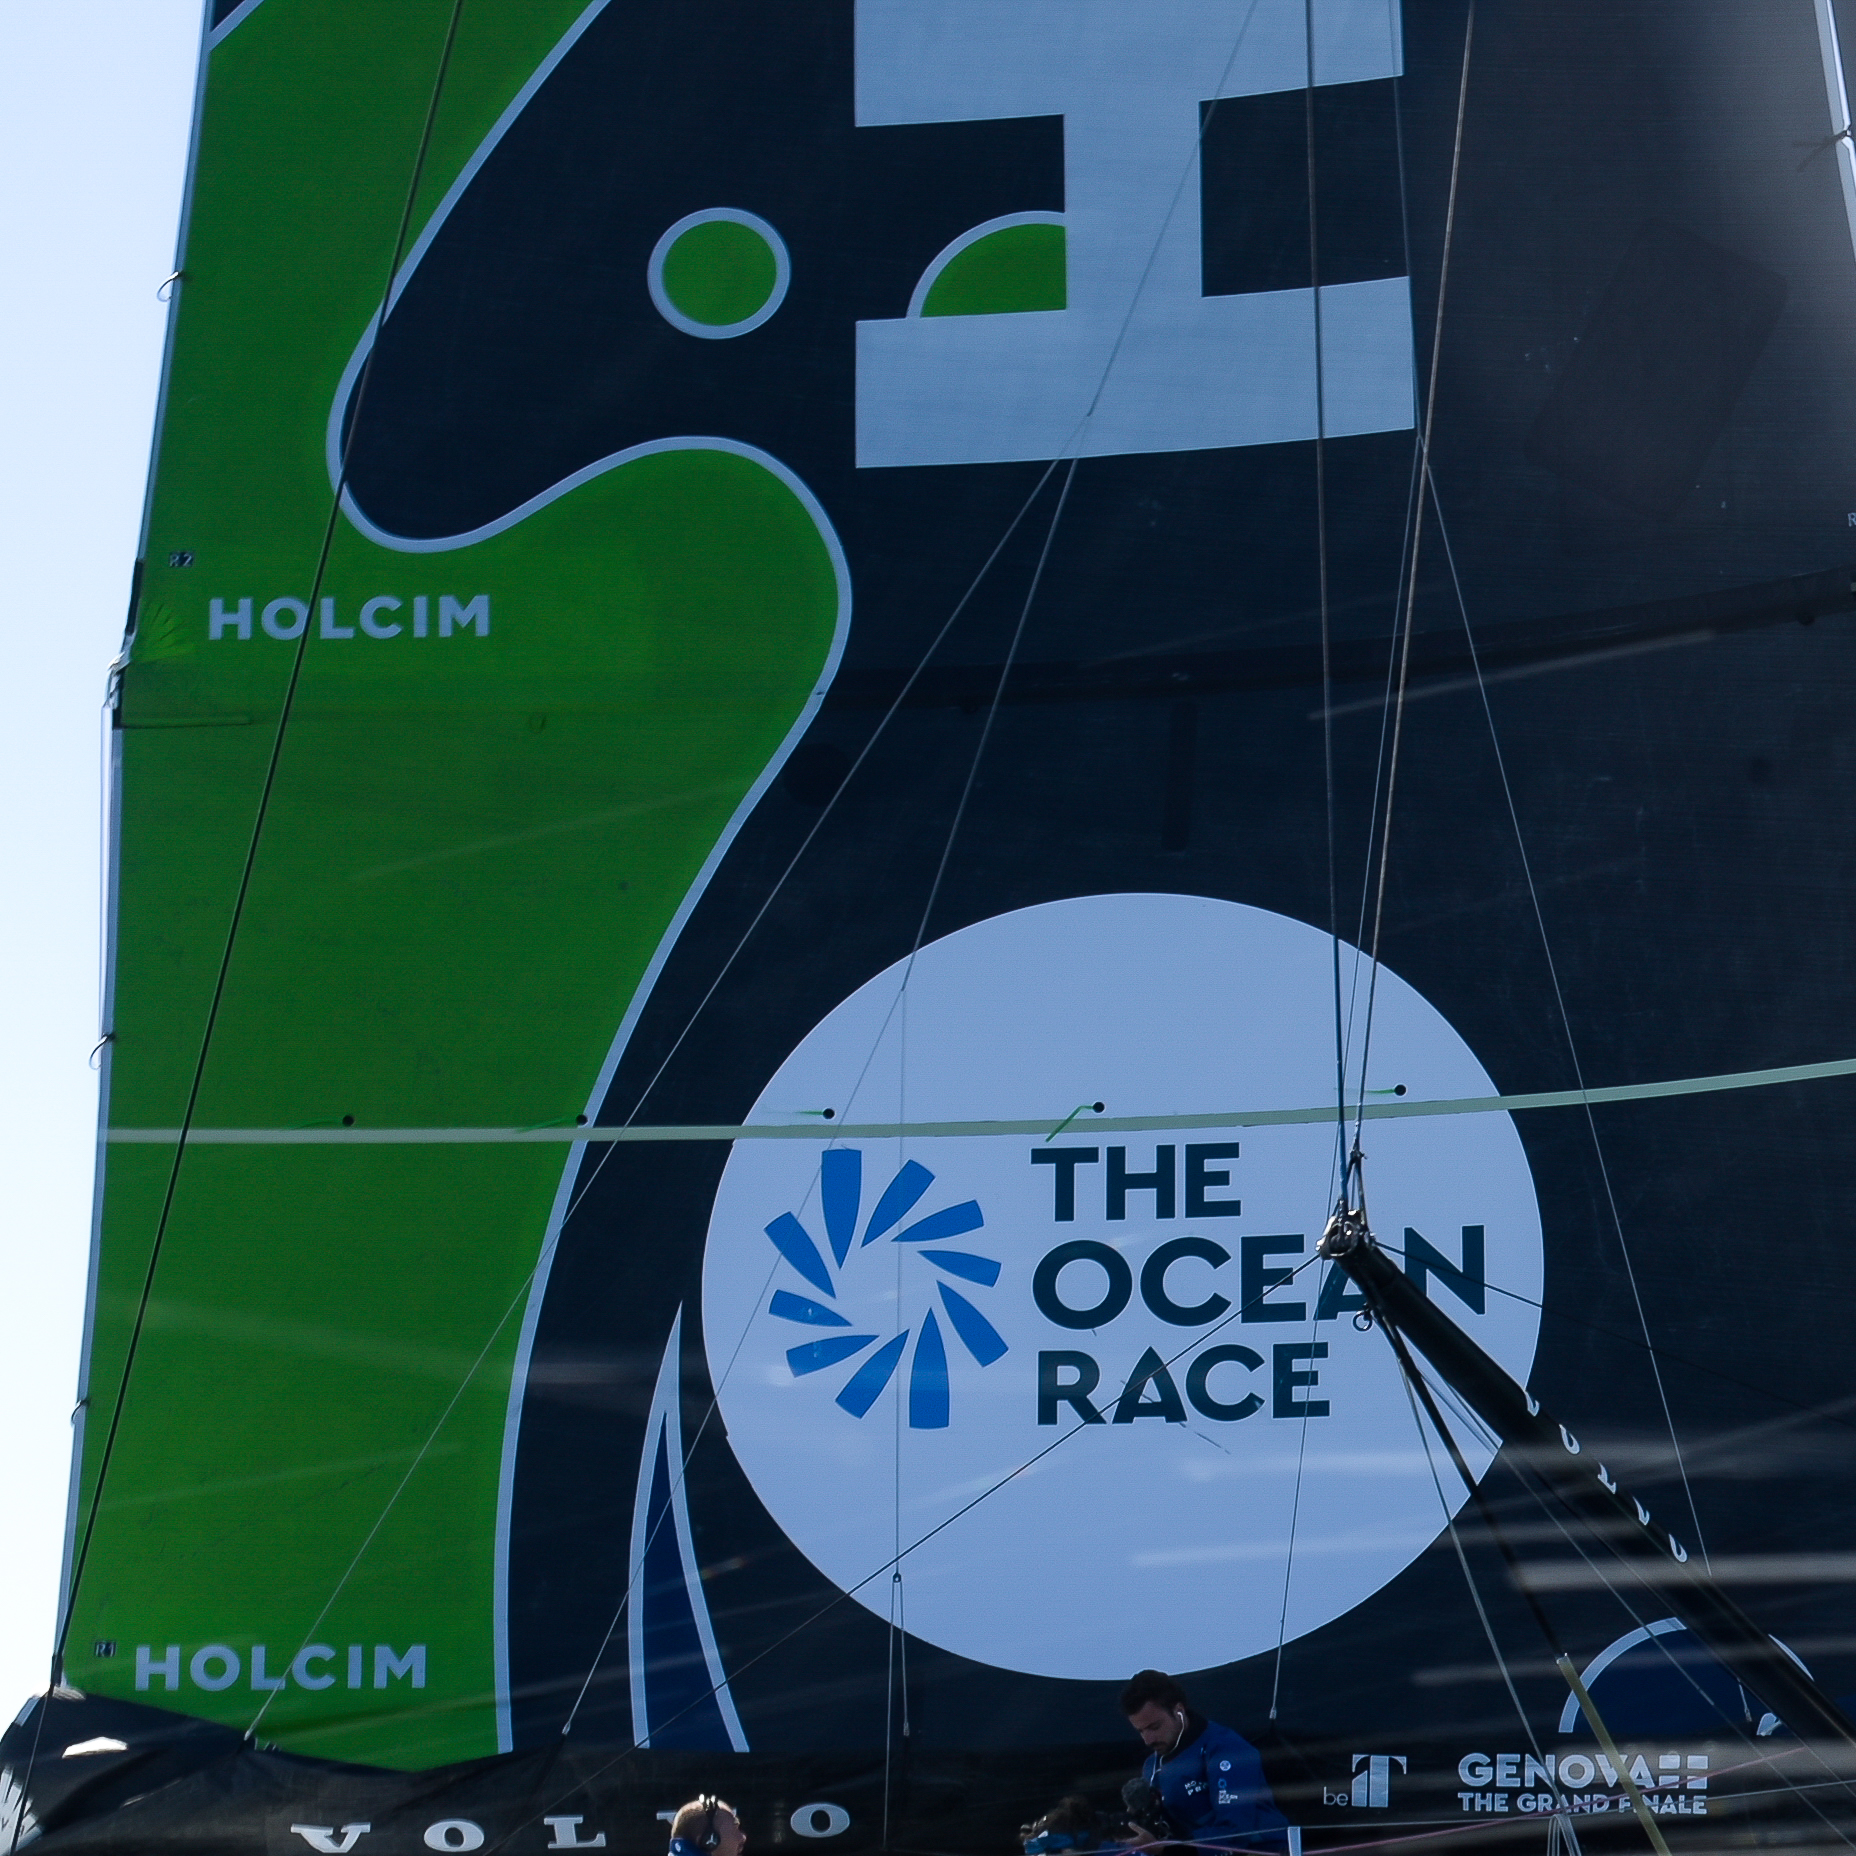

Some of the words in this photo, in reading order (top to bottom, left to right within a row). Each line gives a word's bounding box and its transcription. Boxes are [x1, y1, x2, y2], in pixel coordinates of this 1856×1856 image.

[208, 594, 490, 640] HOLCIM
[1030, 1142, 1241, 1223] THE
[1031, 1225, 1485, 1330] OCEAN
[1036, 1342, 1330, 1426] RACE
[135, 1644, 427, 1692] HOLCIM
[1458, 1753, 1655, 1788] GENOVA
[290, 1802, 851, 1854] VOLO
[1457, 1792, 1509, 1812] THE
[1517, 1793, 1611, 1814] GRAND
[1618, 1794, 1708, 1816] FNALE
